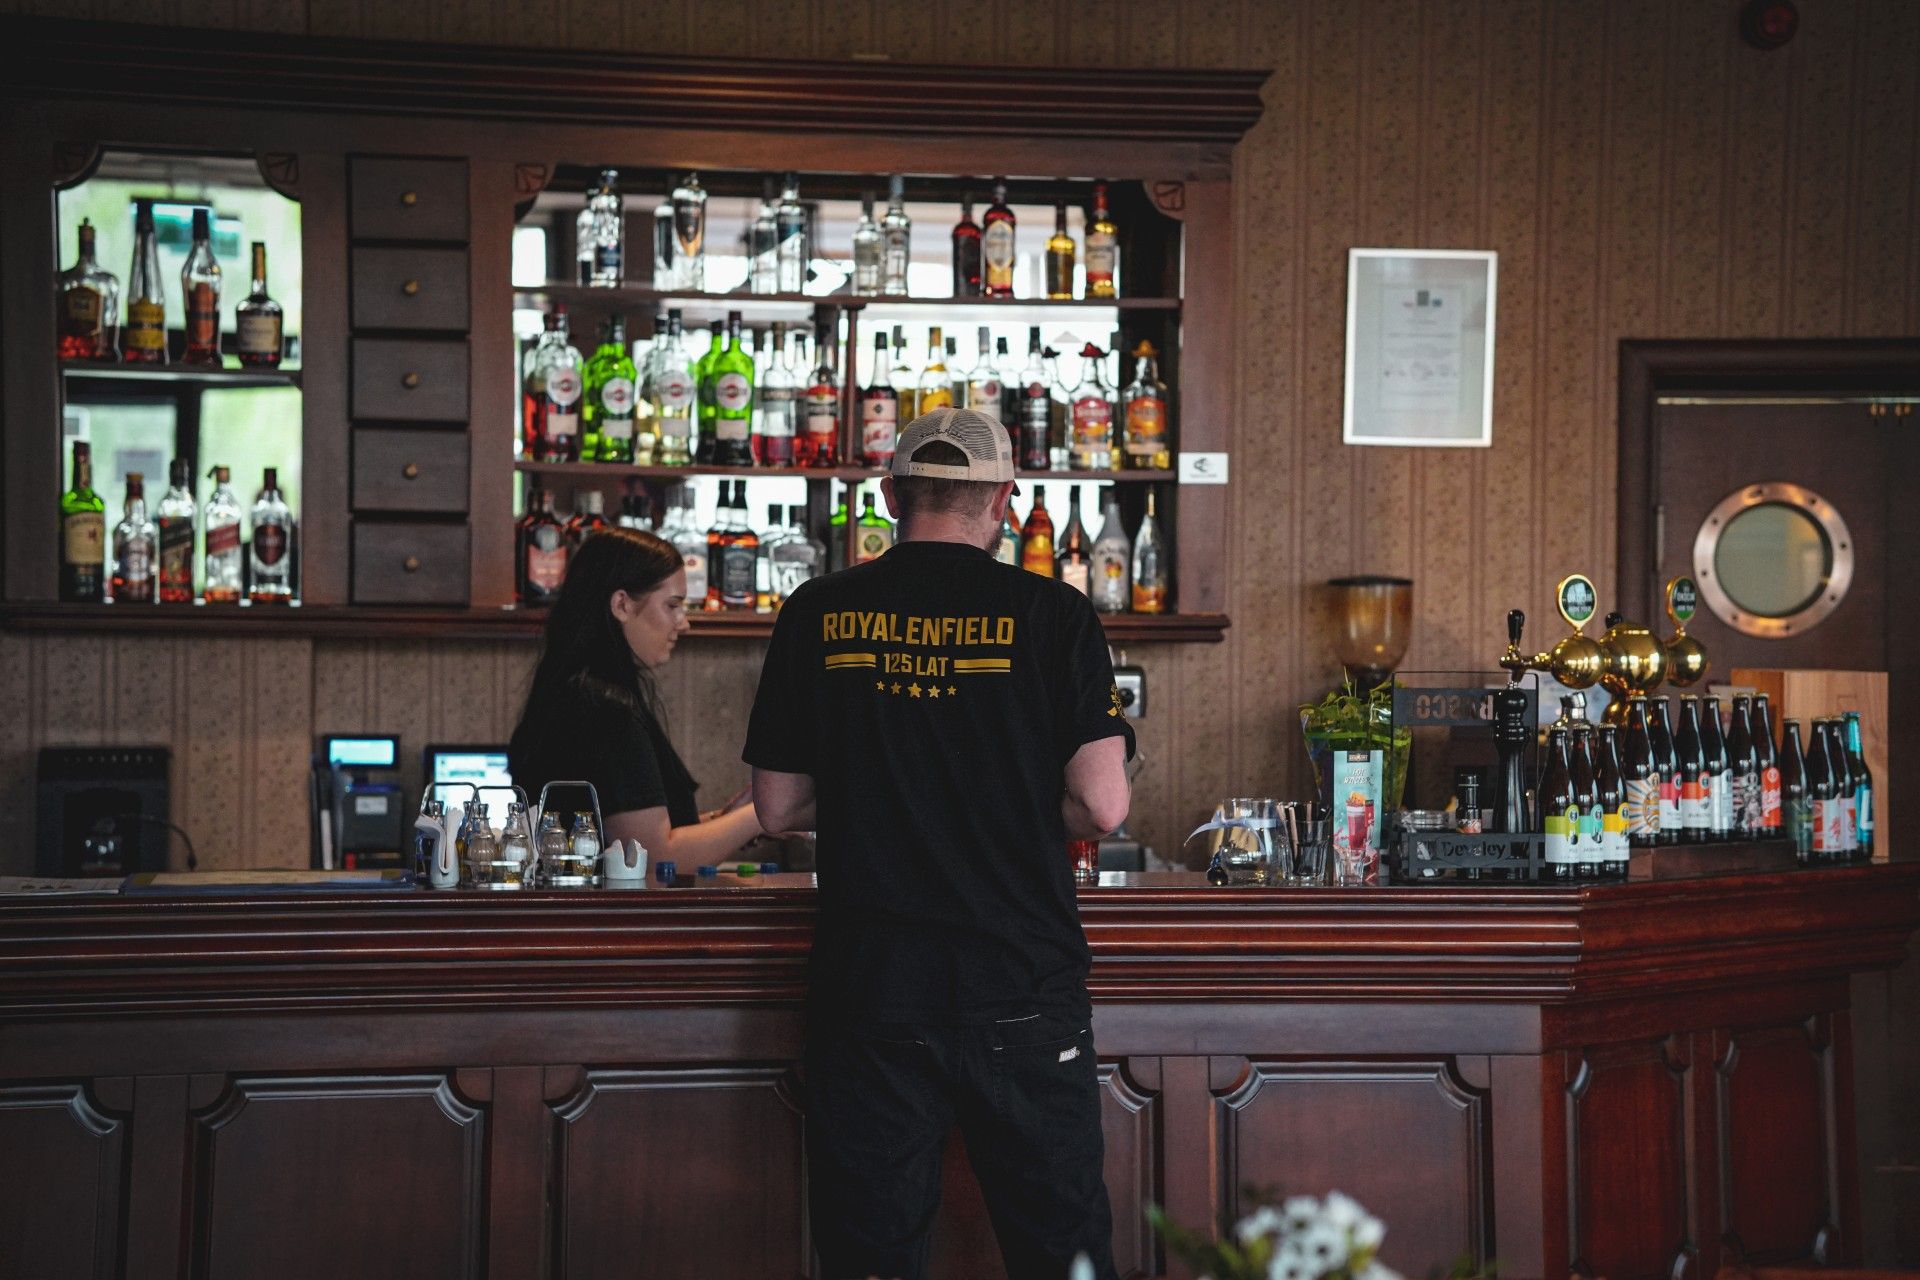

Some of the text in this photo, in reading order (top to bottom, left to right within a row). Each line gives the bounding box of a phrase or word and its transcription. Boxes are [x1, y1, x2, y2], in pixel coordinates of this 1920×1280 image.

[823, 611, 1015, 646] ROYAL ENFIELD
[883, 653, 949, 677] 125 LAT
